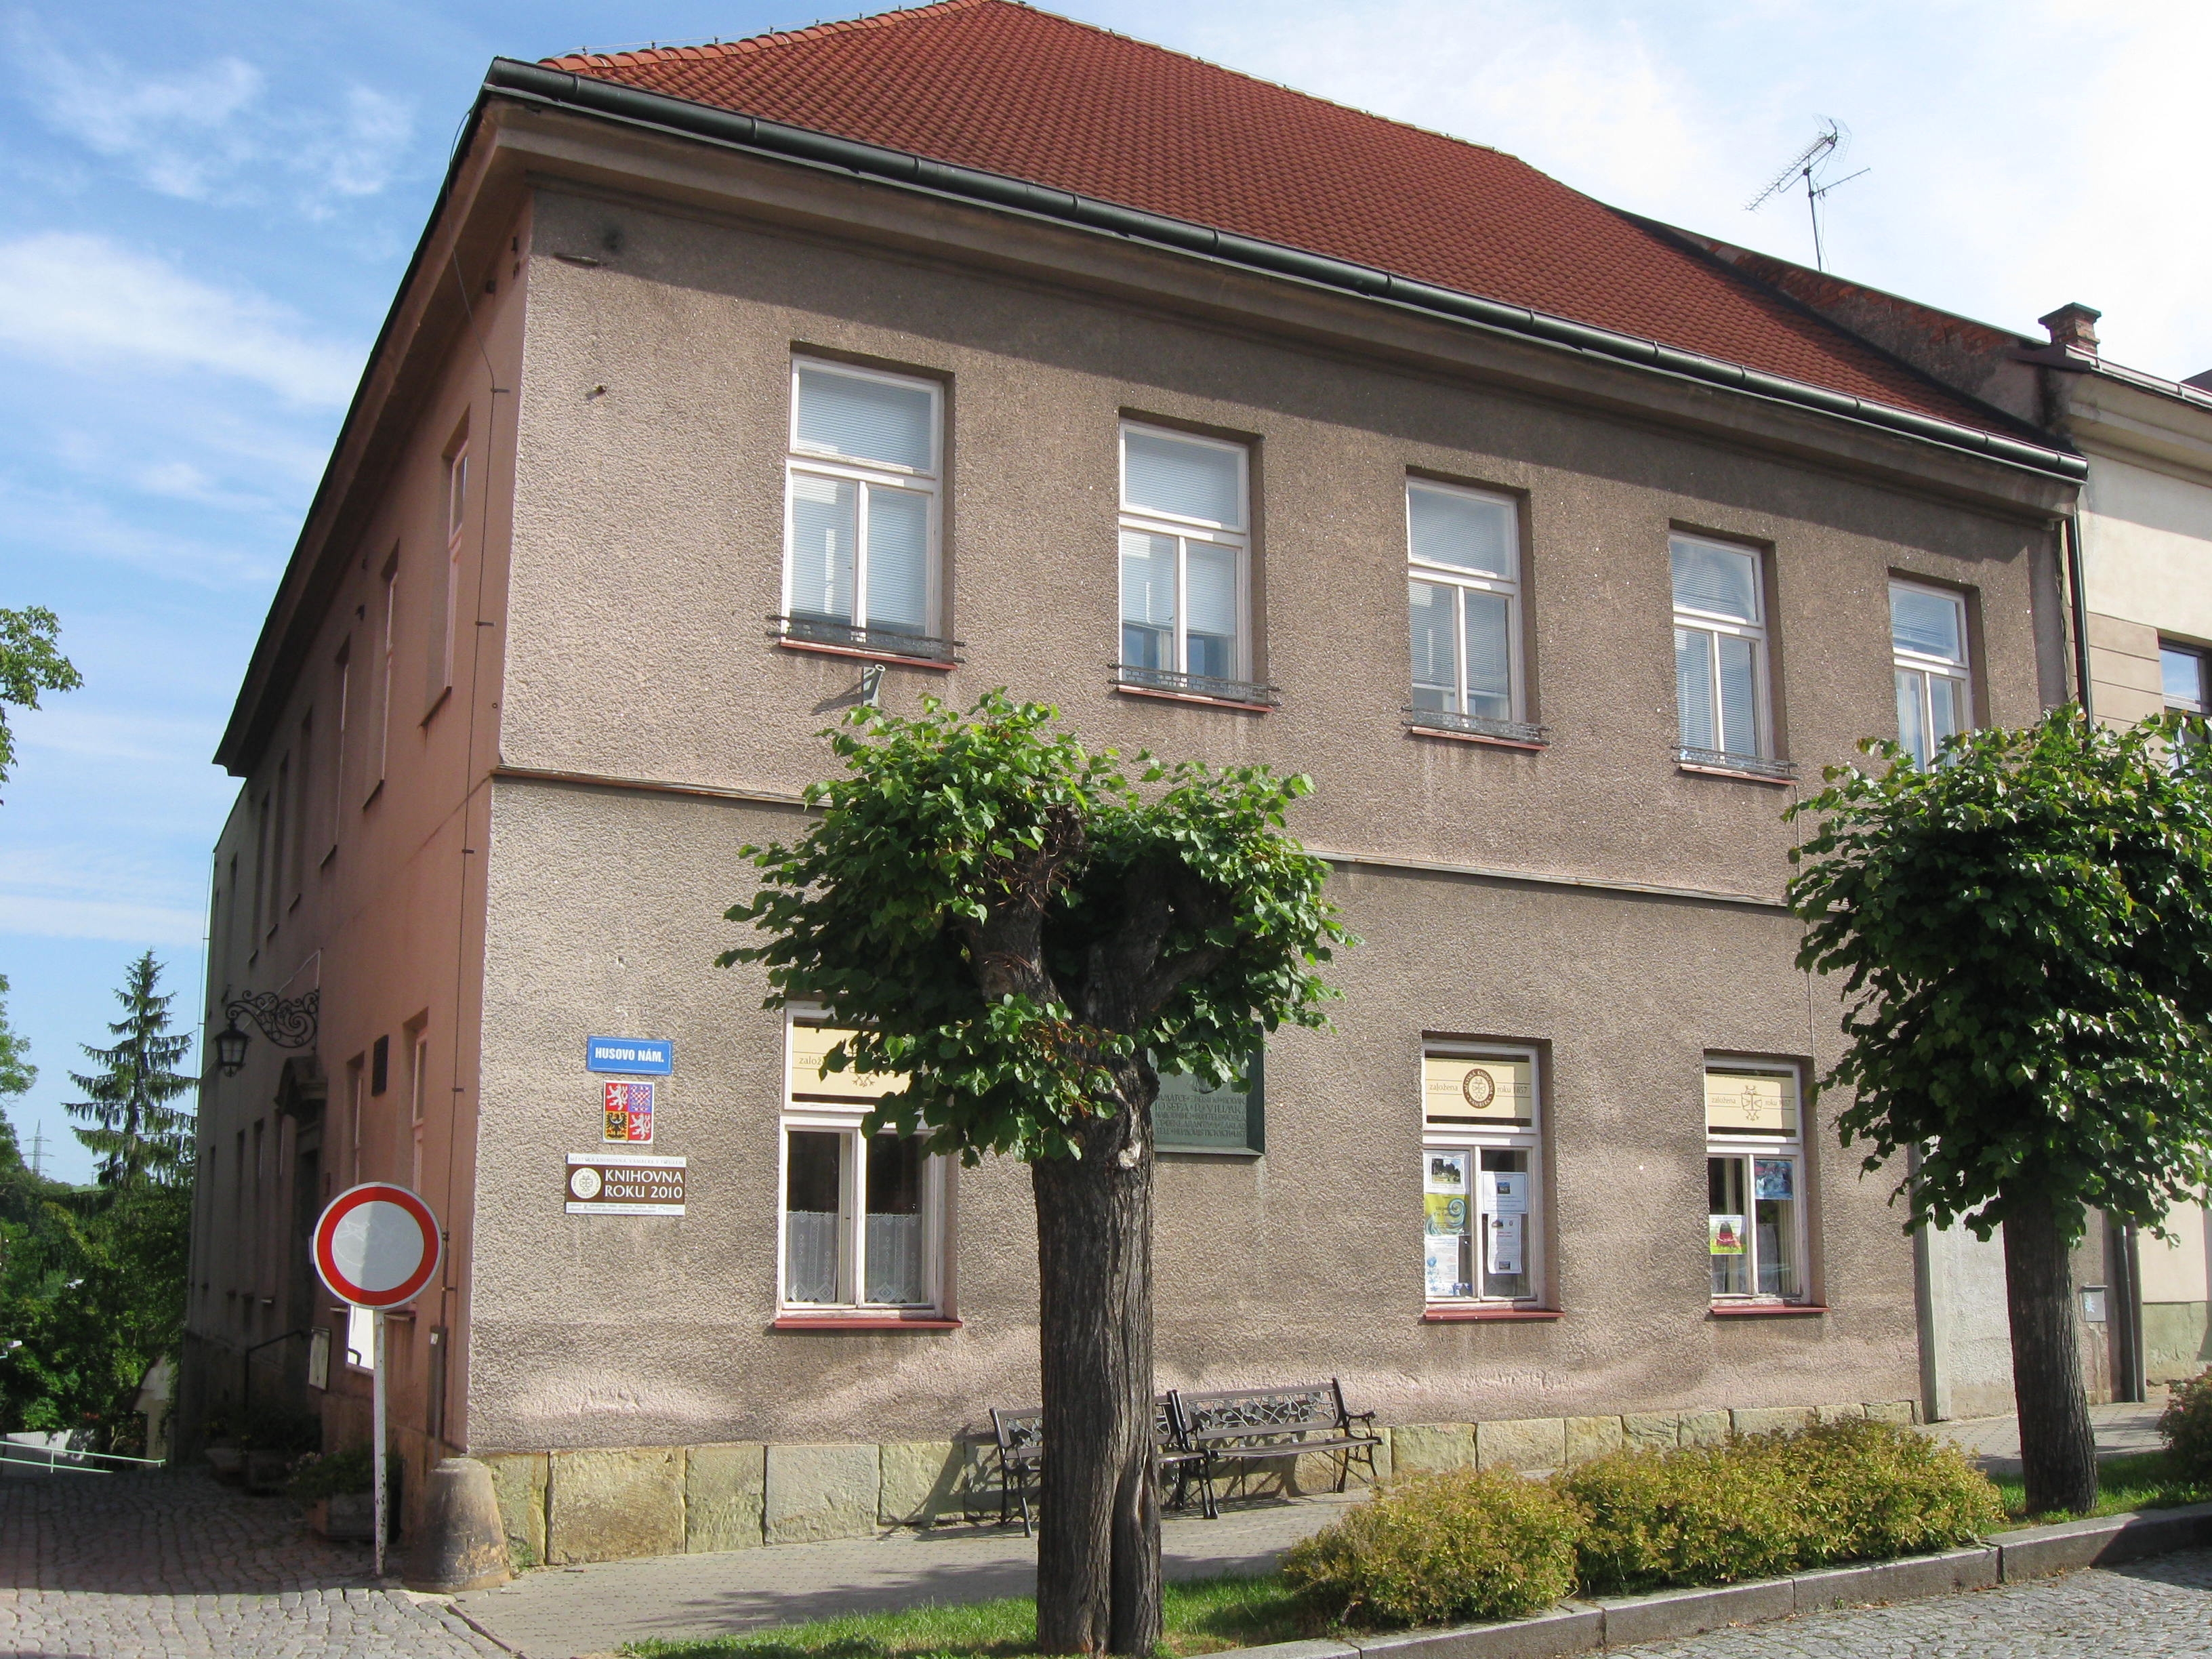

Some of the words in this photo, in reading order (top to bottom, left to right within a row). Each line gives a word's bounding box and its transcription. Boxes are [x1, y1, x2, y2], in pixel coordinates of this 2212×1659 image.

[595, 1047, 635, 1061] HUSOVO
[637, 1048, 664, 1063] NÁM.
[799, 1056, 824, 1065] založ
[1429, 1083, 1458, 1092] založena
[1711, 1095, 1736, 1104] založena
[605, 1169, 684, 1184] KNIHOVNA
[605, 1185, 645, 1198] ROKU
[651, 1186, 683, 1199] 2010
